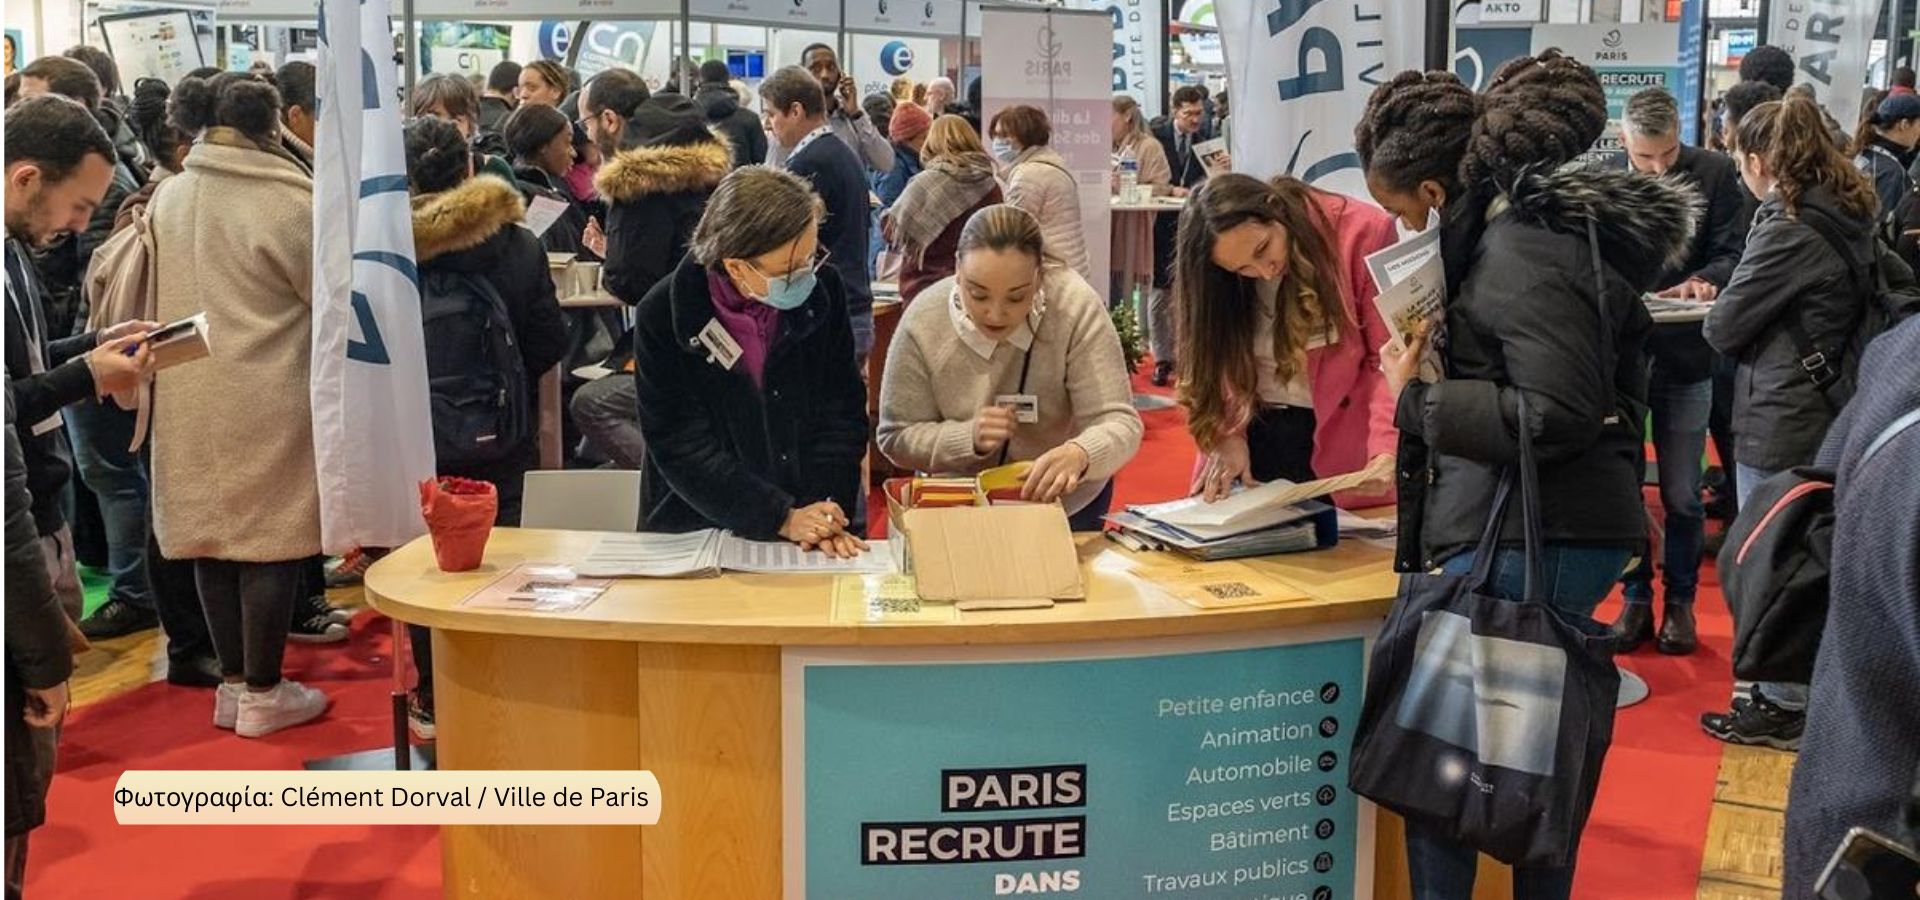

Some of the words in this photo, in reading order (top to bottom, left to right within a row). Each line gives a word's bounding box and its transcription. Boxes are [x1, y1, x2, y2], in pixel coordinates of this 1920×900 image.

[1486, 3, 1520, 13] AKTO
[1595, 52, 1628, 60] PARIS
[1601, 74, 1665, 84] RECRUTE
[1158, 695, 1224, 718] Petite
[1229, 688, 1315, 711] enfance
[1201, 722, 1312, 750] Animation
[1186, 755, 1312, 785] Automobile
[948, 770, 1082, 808] PARIS
[1167, 799, 1255, 823] Espaces
[1260, 791, 1311, 811] verts
[867, 822, 1080, 861] RECRUTE
[1210, 823, 1309, 851] Bâtiment
[995, 870, 1080, 896] DANS
[1143, 870, 1228, 893] Travaux
[1234, 857, 1309, 886] publics
